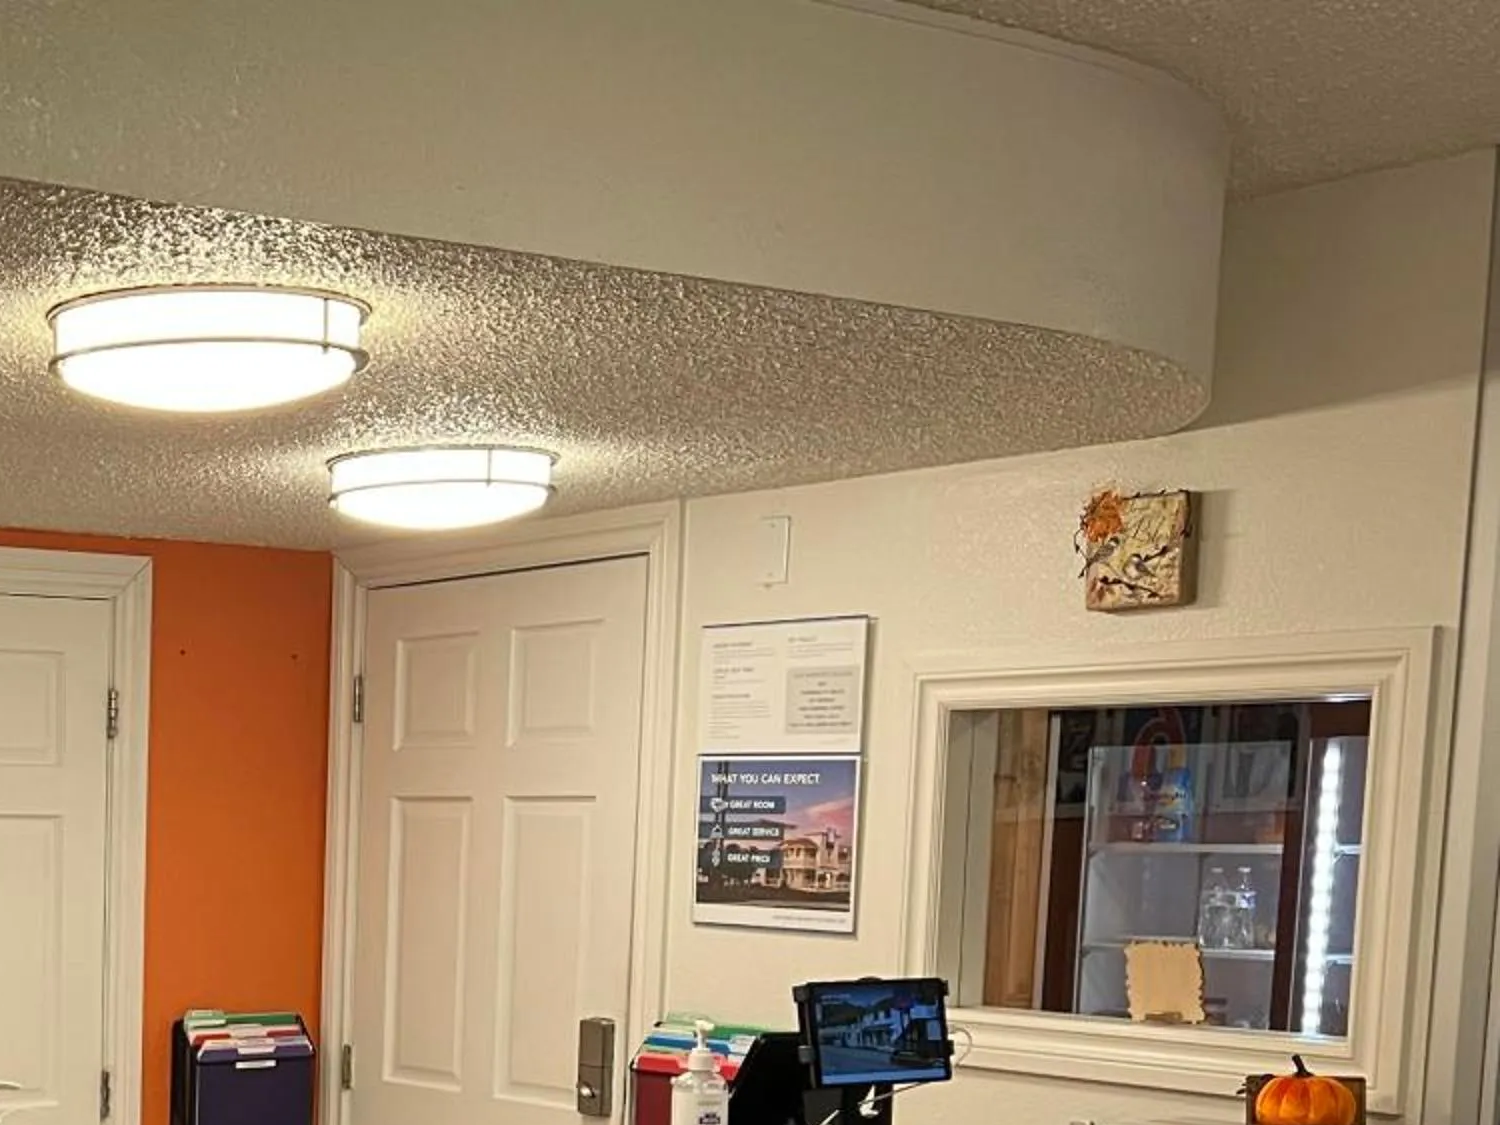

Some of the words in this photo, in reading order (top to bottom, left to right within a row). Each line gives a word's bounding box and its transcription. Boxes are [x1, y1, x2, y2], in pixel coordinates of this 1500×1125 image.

[711, 773, 738, 783] WHAT
[741, 773, 759, 784] YOU
[761, 773, 781, 784] CAN
[784, 773, 820, 784] EXPECT
